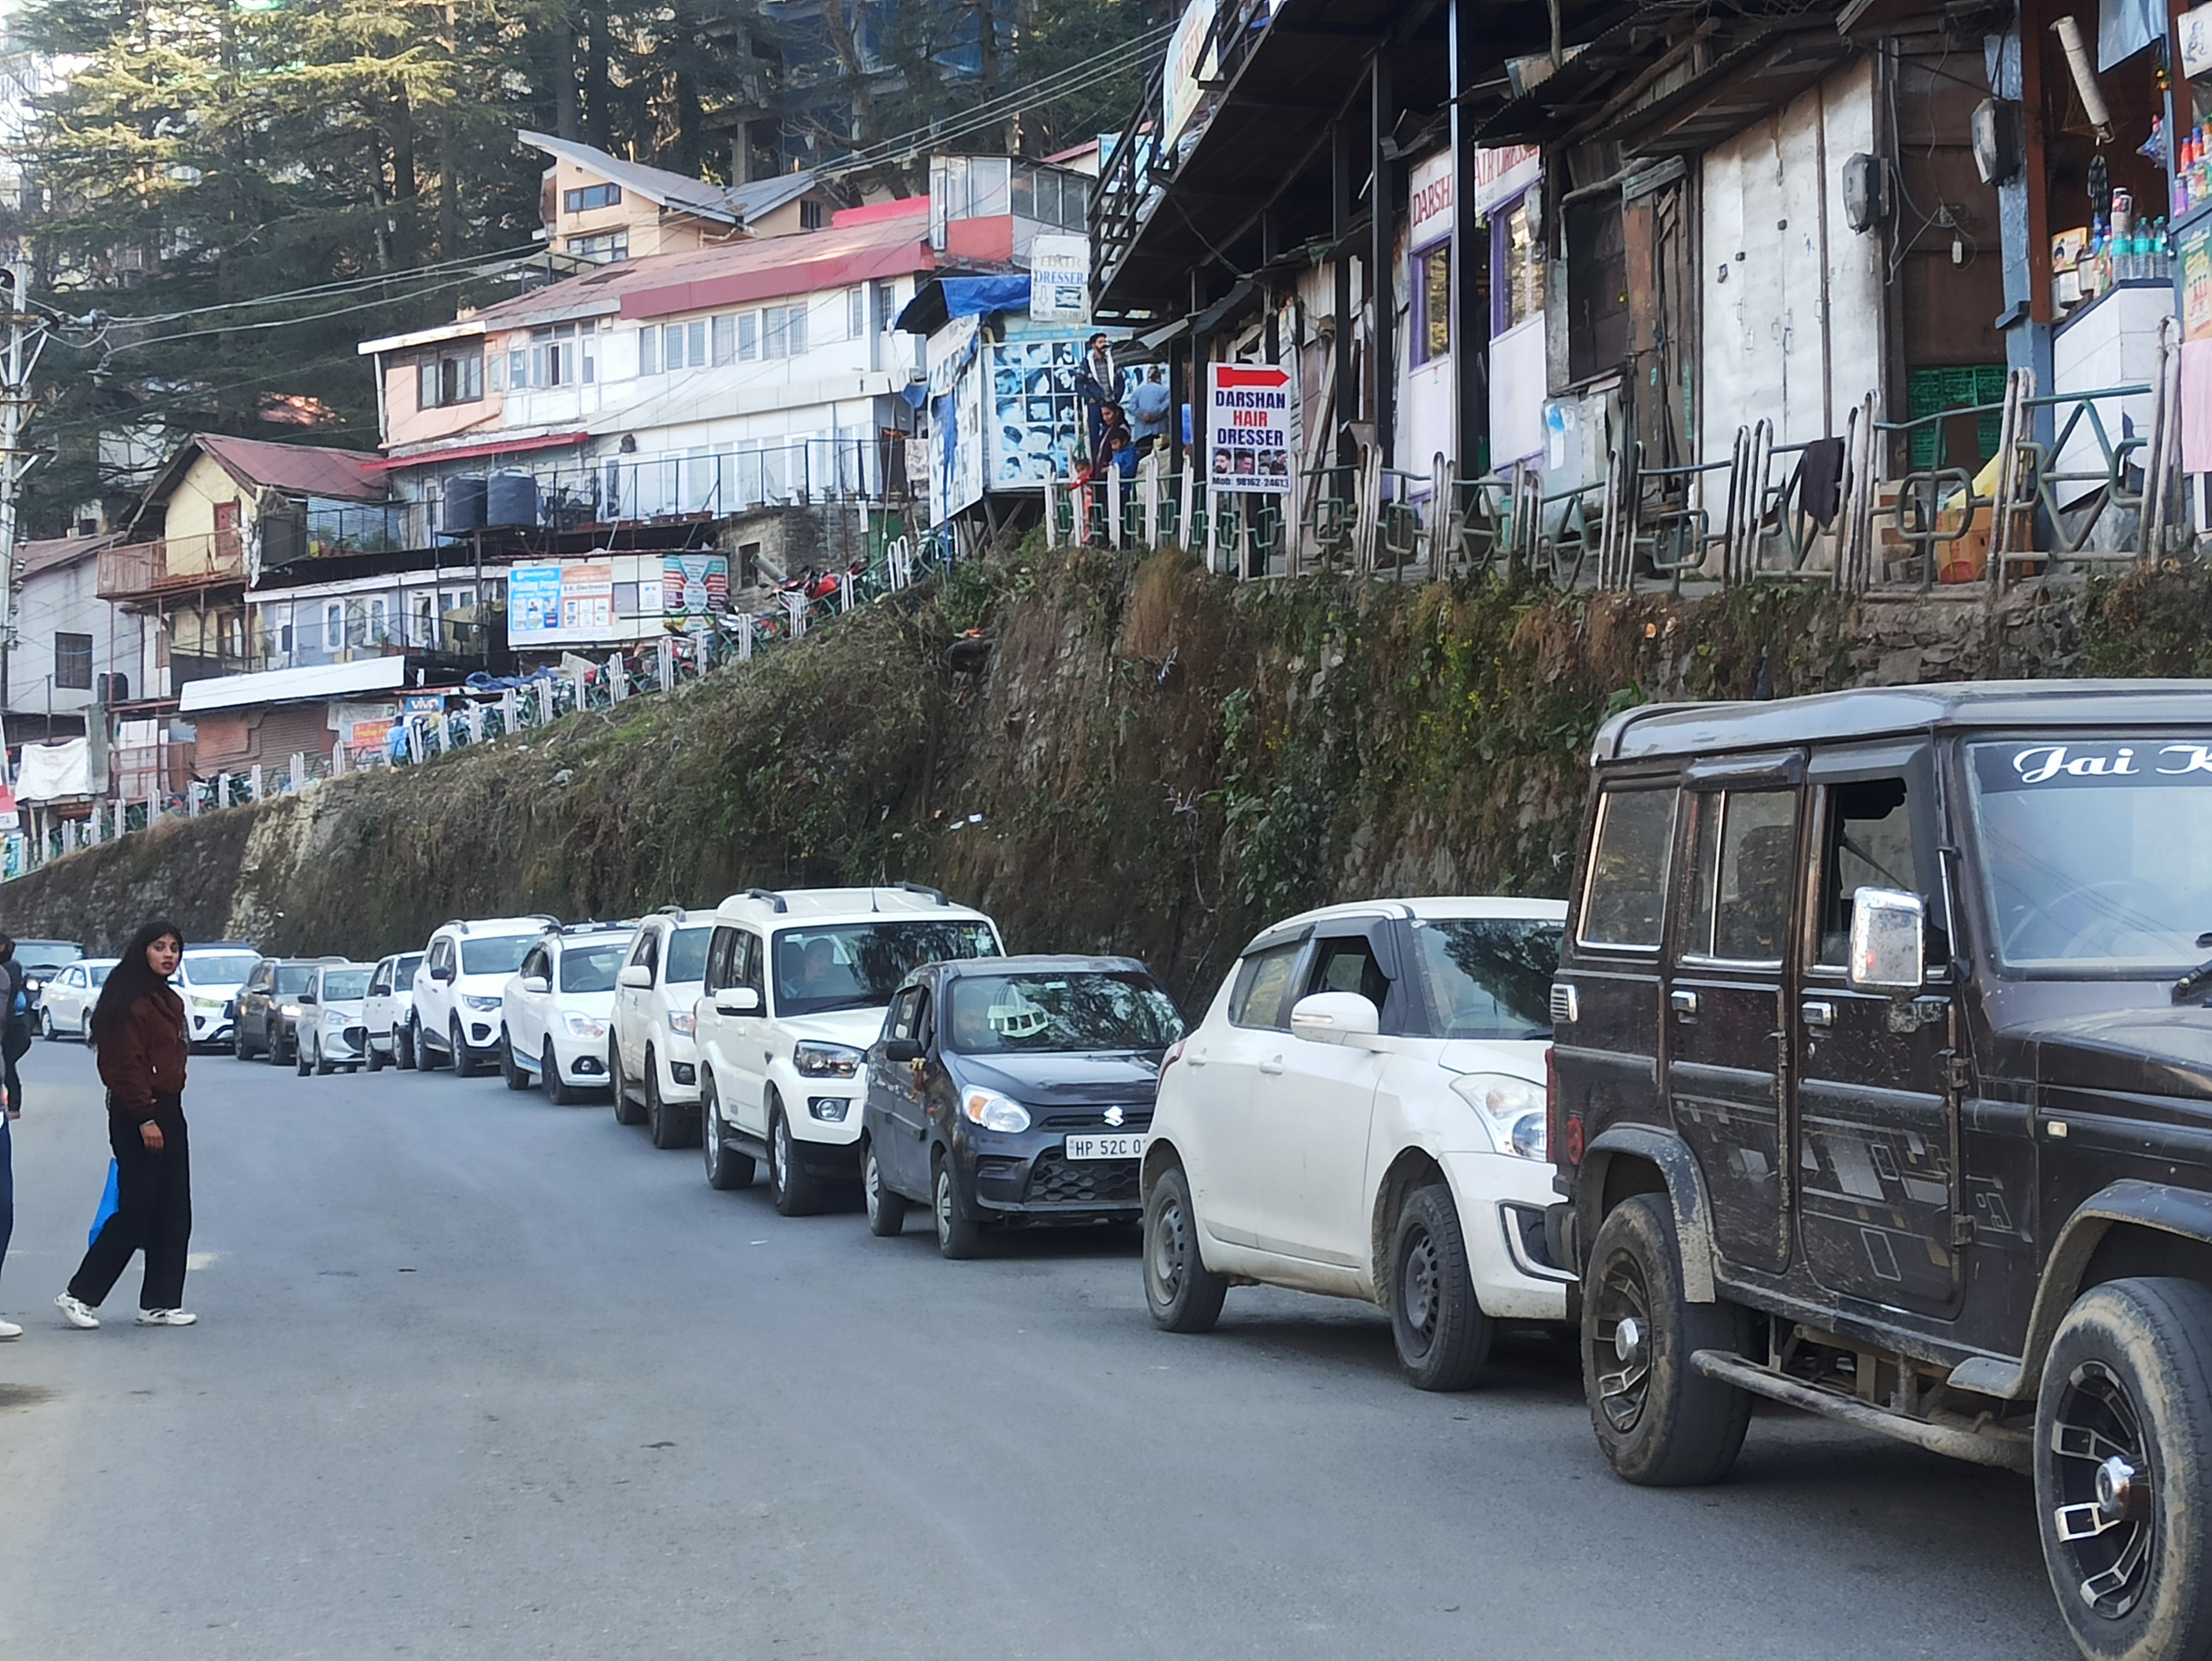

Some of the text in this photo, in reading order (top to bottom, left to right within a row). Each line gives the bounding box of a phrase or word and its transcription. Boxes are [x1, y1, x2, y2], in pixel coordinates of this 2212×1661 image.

[1413, 173, 1453, 227] DARSH
[1475, 149, 1493, 187] AIR
[1035, 270, 1084, 285] DRESSER
[1216, 391, 1285, 409] DARSHAN
[1233, 410, 1268, 427] HAIR
[1217, 428, 1283, 446] DRESSER
[411, 697, 439, 709] vivo
[2013, 747, 2140, 784] Jai
[1076, 1139, 1146, 1156] HP 52C 0
